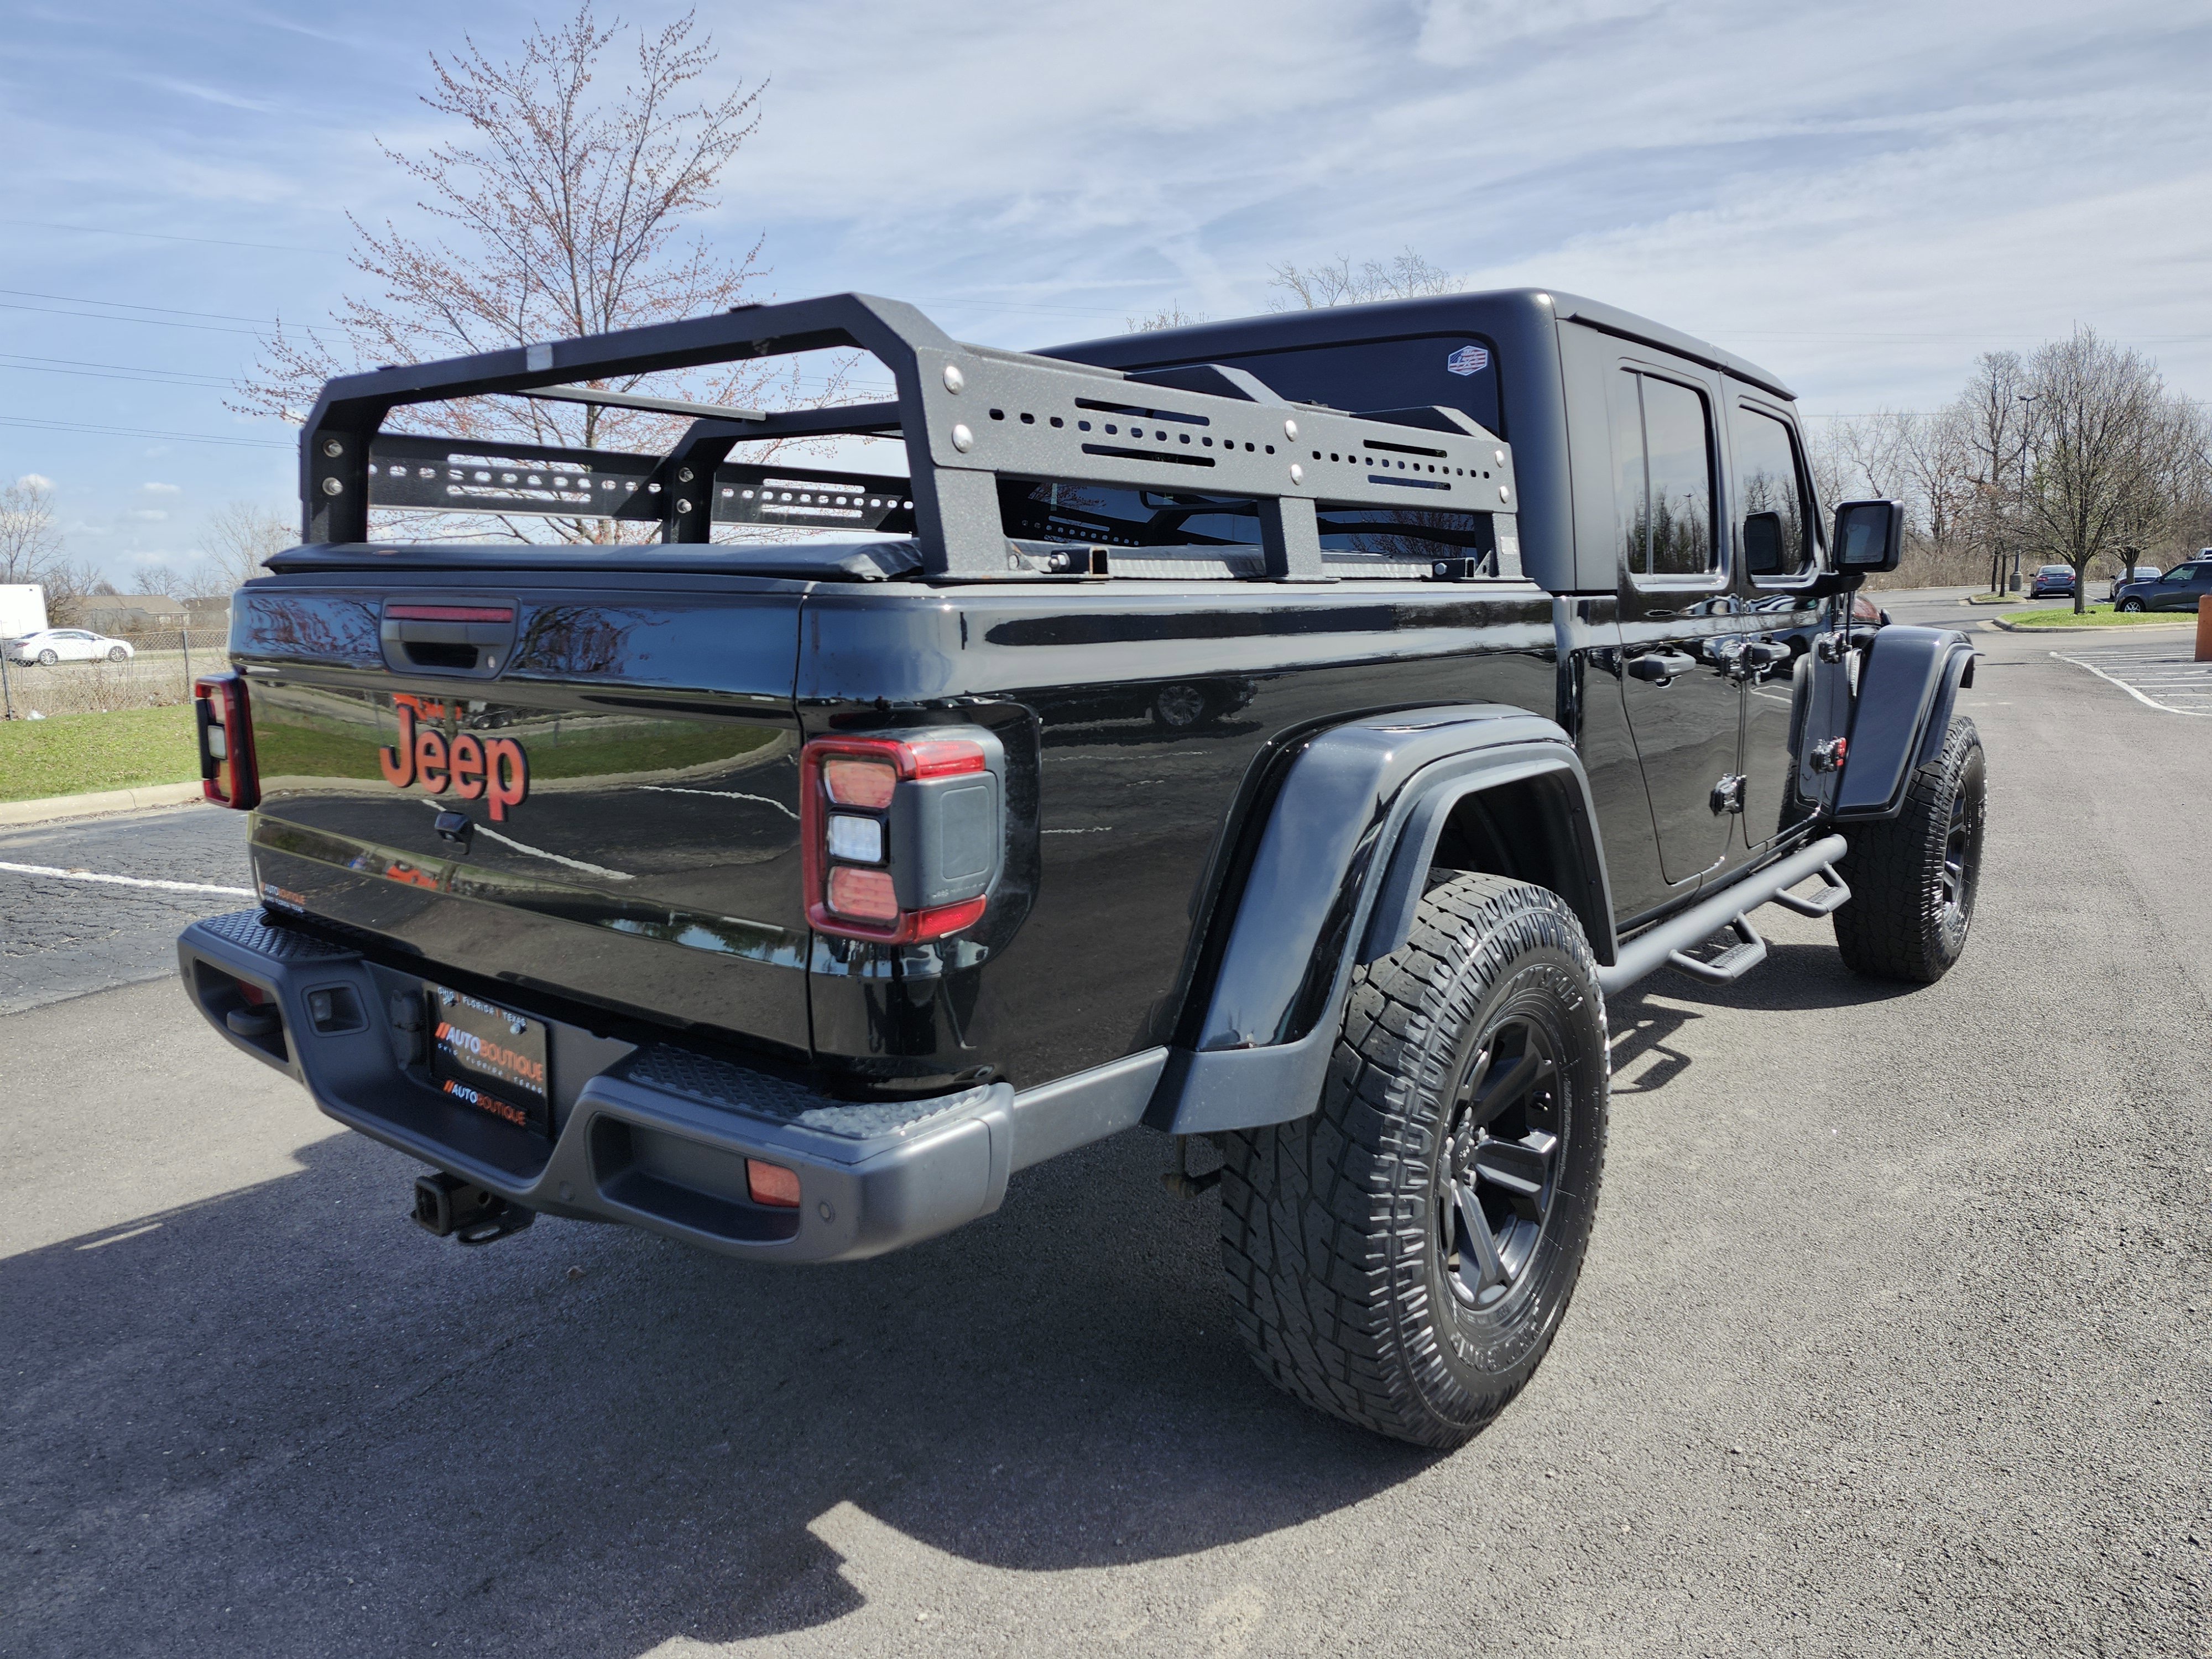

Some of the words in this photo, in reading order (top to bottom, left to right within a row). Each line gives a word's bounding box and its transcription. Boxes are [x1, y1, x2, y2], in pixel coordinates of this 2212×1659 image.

[379, 702, 529, 822] Jeep
[1537, 966, 1584, 1011] SPORT
[462, 996, 495, 1016] FLORIDA
[503, 1011, 526, 1027] TEXAS
[446, 1026, 543, 1082] AUTOBOUTIQUE
[451, 1083, 526, 1127] AUTOBOUTIQUE
